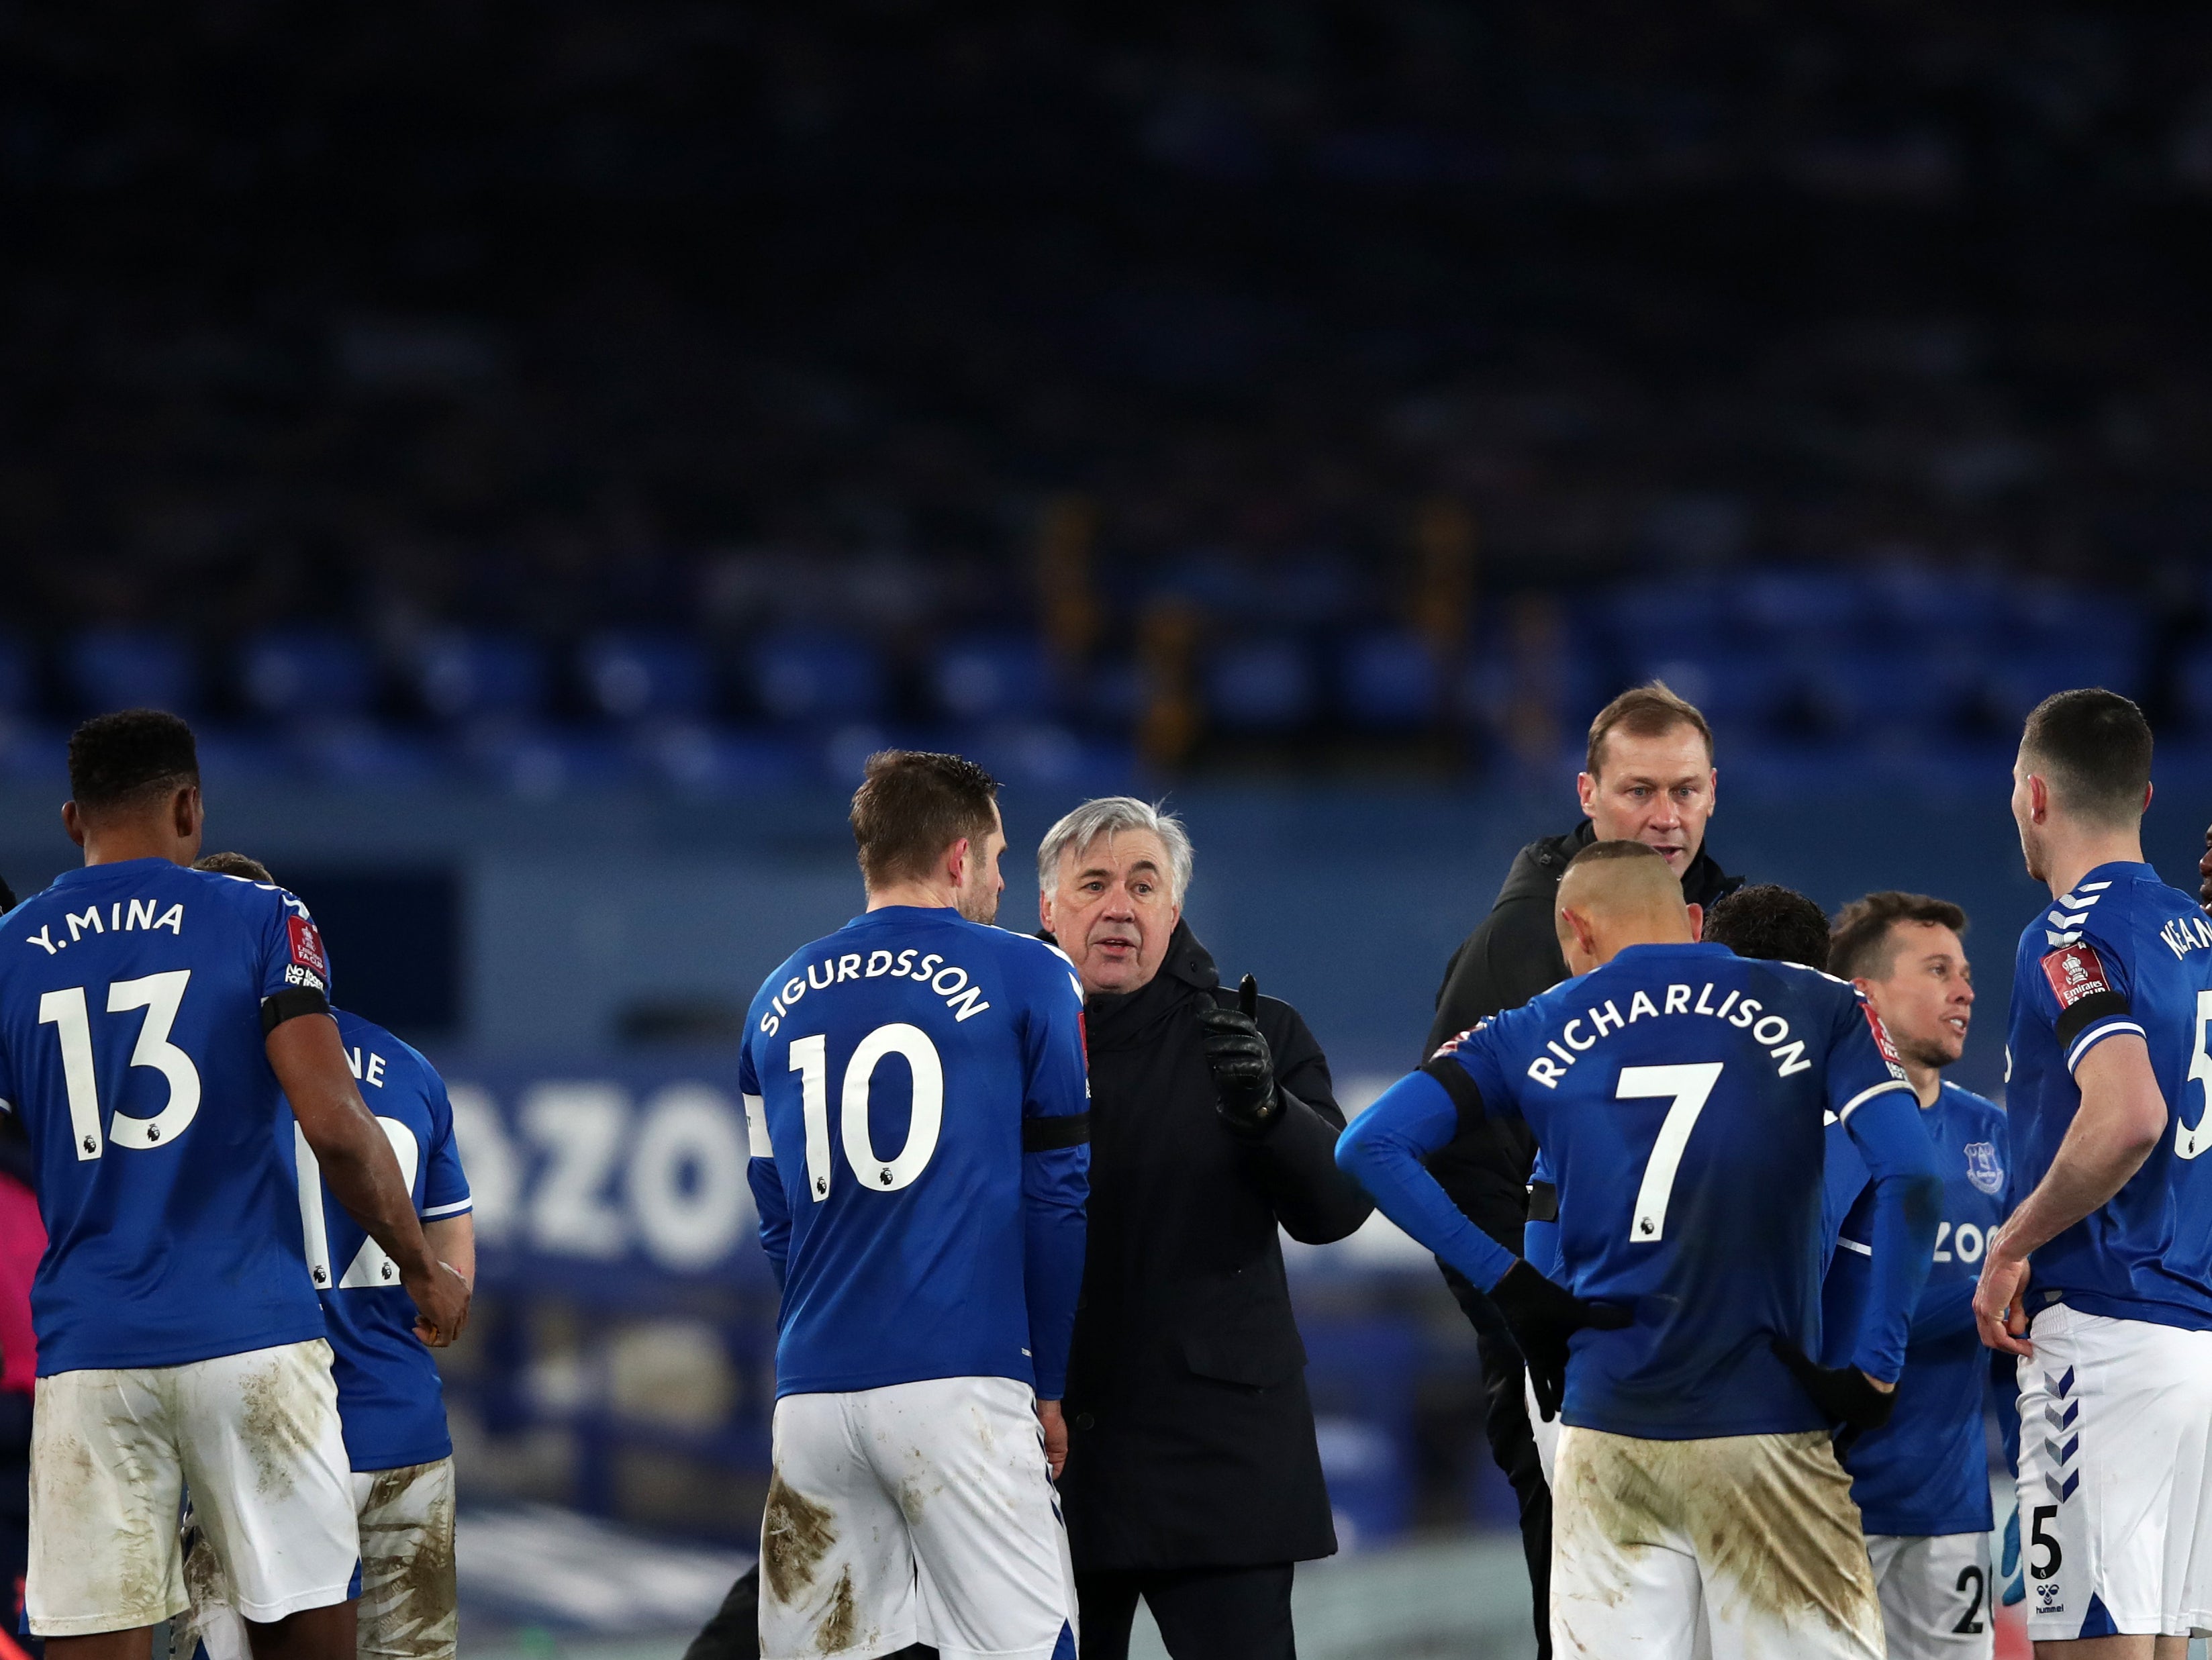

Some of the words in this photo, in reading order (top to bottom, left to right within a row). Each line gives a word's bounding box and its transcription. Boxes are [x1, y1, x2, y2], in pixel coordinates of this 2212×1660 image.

[26, 898, 184, 955] Y.MINA
[760, 948, 991, 1038] SIGURDSSON
[1527, 981, 1812, 1089] RICHARLISON
[2064, 980, 2103, 1000] Emirates
[38, 969, 201, 1162] 13
[789, 1022, 945, 1203] 10
[1615, 1061, 1725, 1243] 7
[2029, 1504, 2062, 1580] 5
[1951, 1563, 1994, 1634] 2
